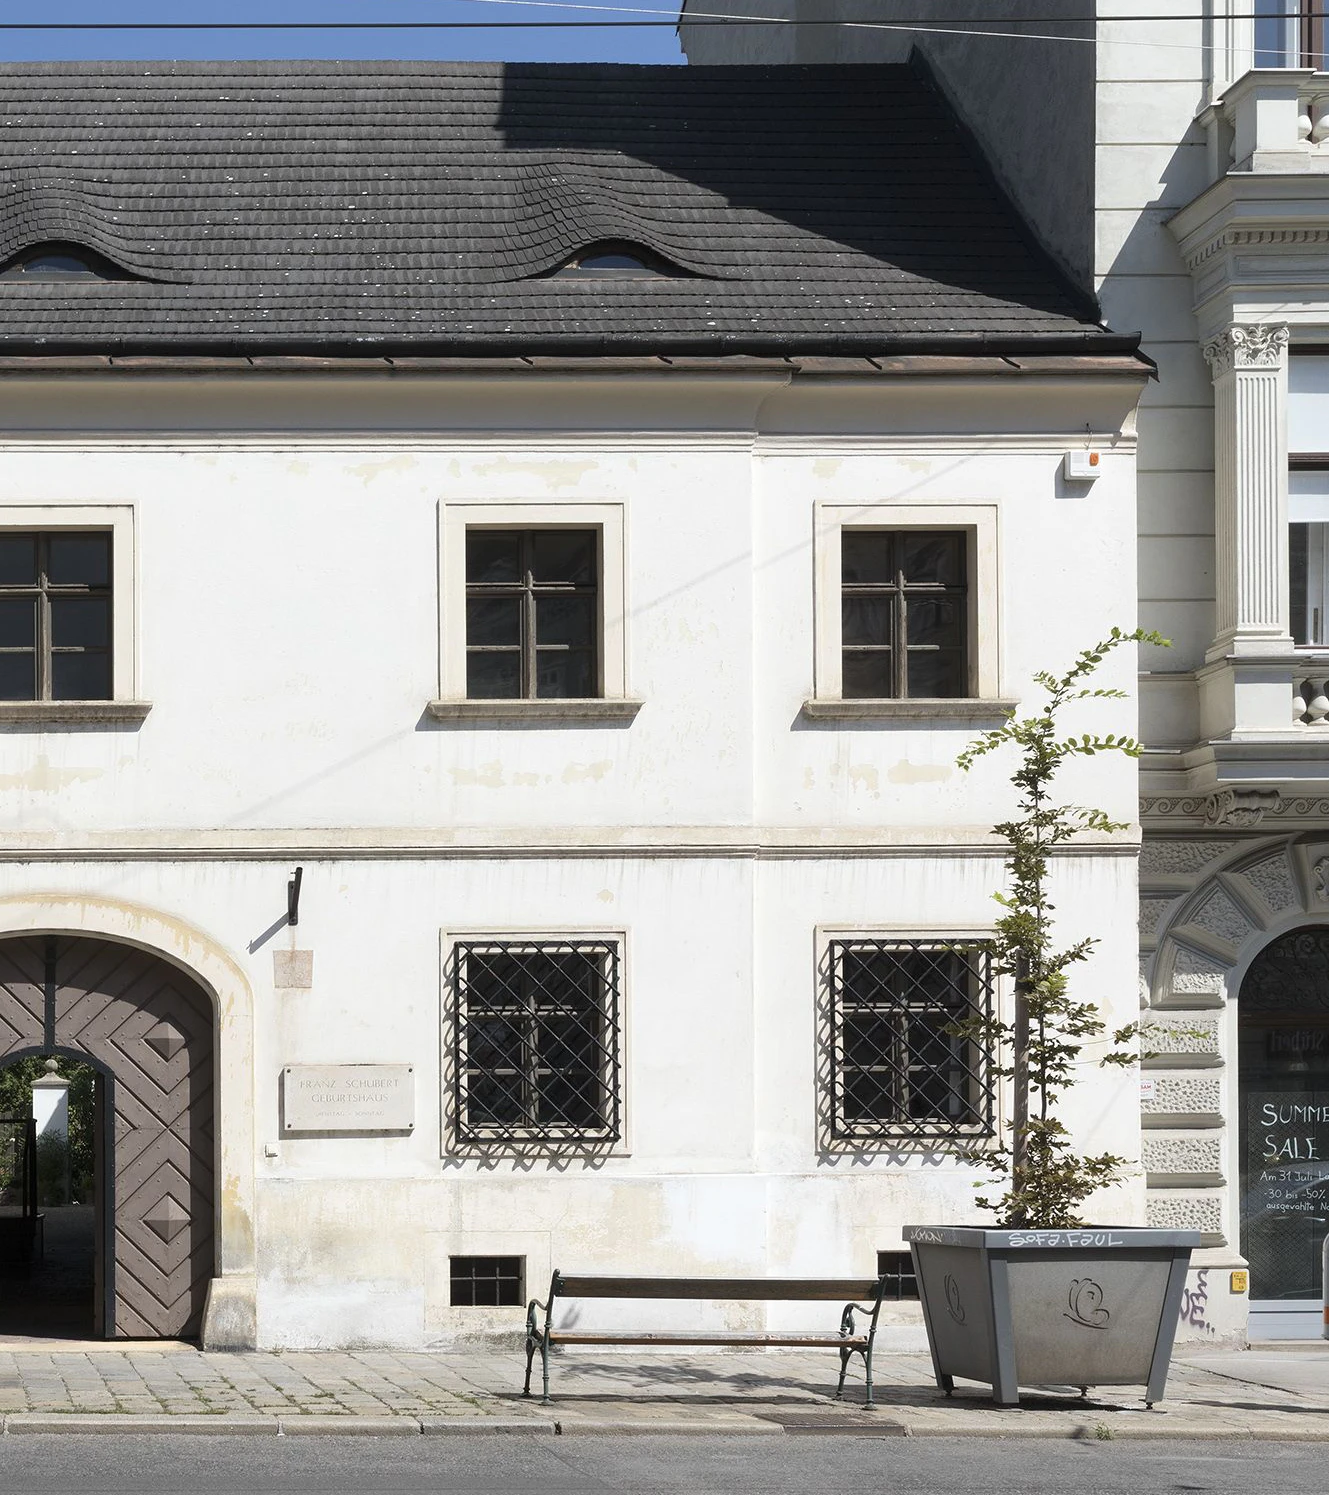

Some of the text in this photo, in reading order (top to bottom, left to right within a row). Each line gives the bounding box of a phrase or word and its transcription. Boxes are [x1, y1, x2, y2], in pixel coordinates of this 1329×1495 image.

[300, 1080, 399, 1088] FRANZ SCHUBERT
[311, 1094, 389, 1103] GEBURTSHAUS
[1262, 1134, 1321, 1160] SALE
[1259, 1170, 1277, 1181] Am
[1285, 1190, 1298, 1199] bis
